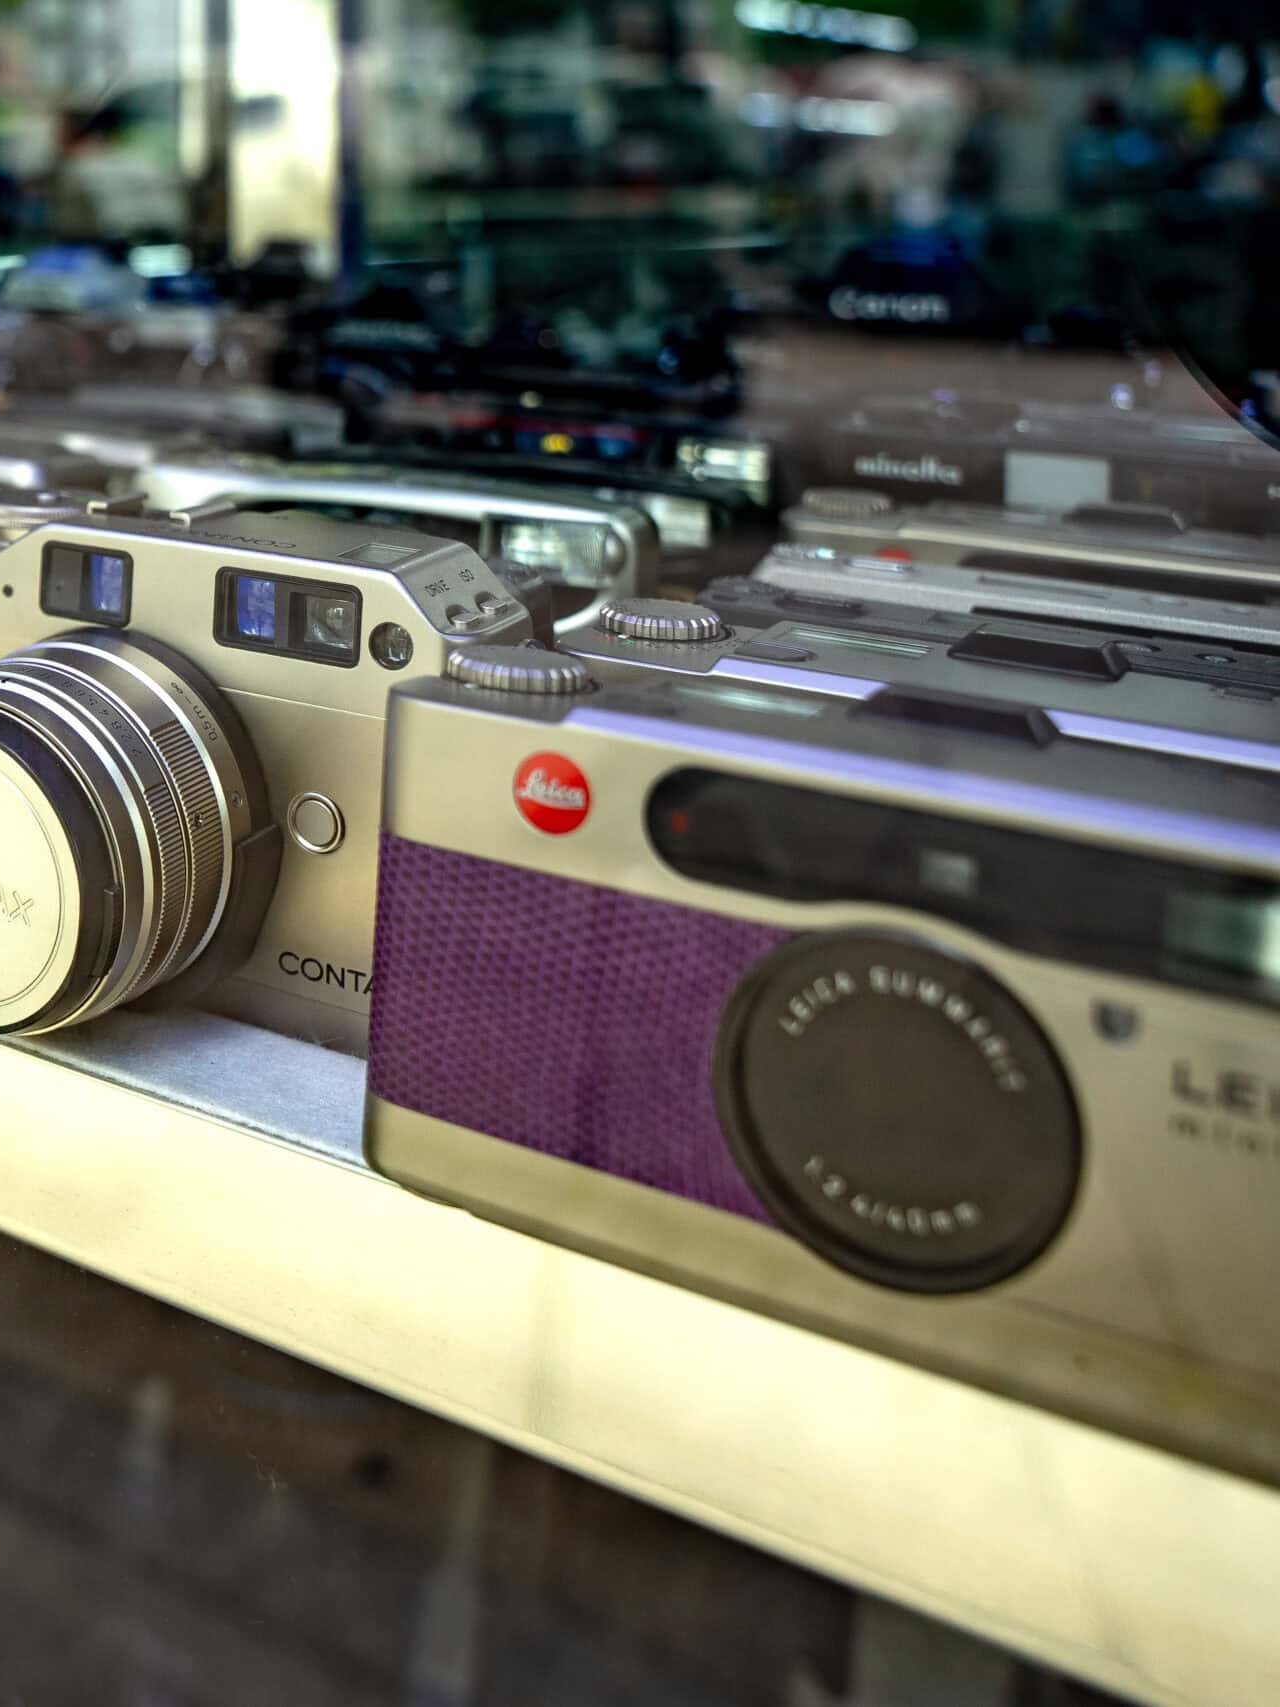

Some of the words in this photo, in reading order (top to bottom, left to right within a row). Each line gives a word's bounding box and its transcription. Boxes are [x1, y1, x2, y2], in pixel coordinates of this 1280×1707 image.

[829, 285, 950, 322] Canon
[854, 450, 962, 485] minolta
[516, 767, 584, 809] Leica
[778, 969, 857, 1038] LEICA
